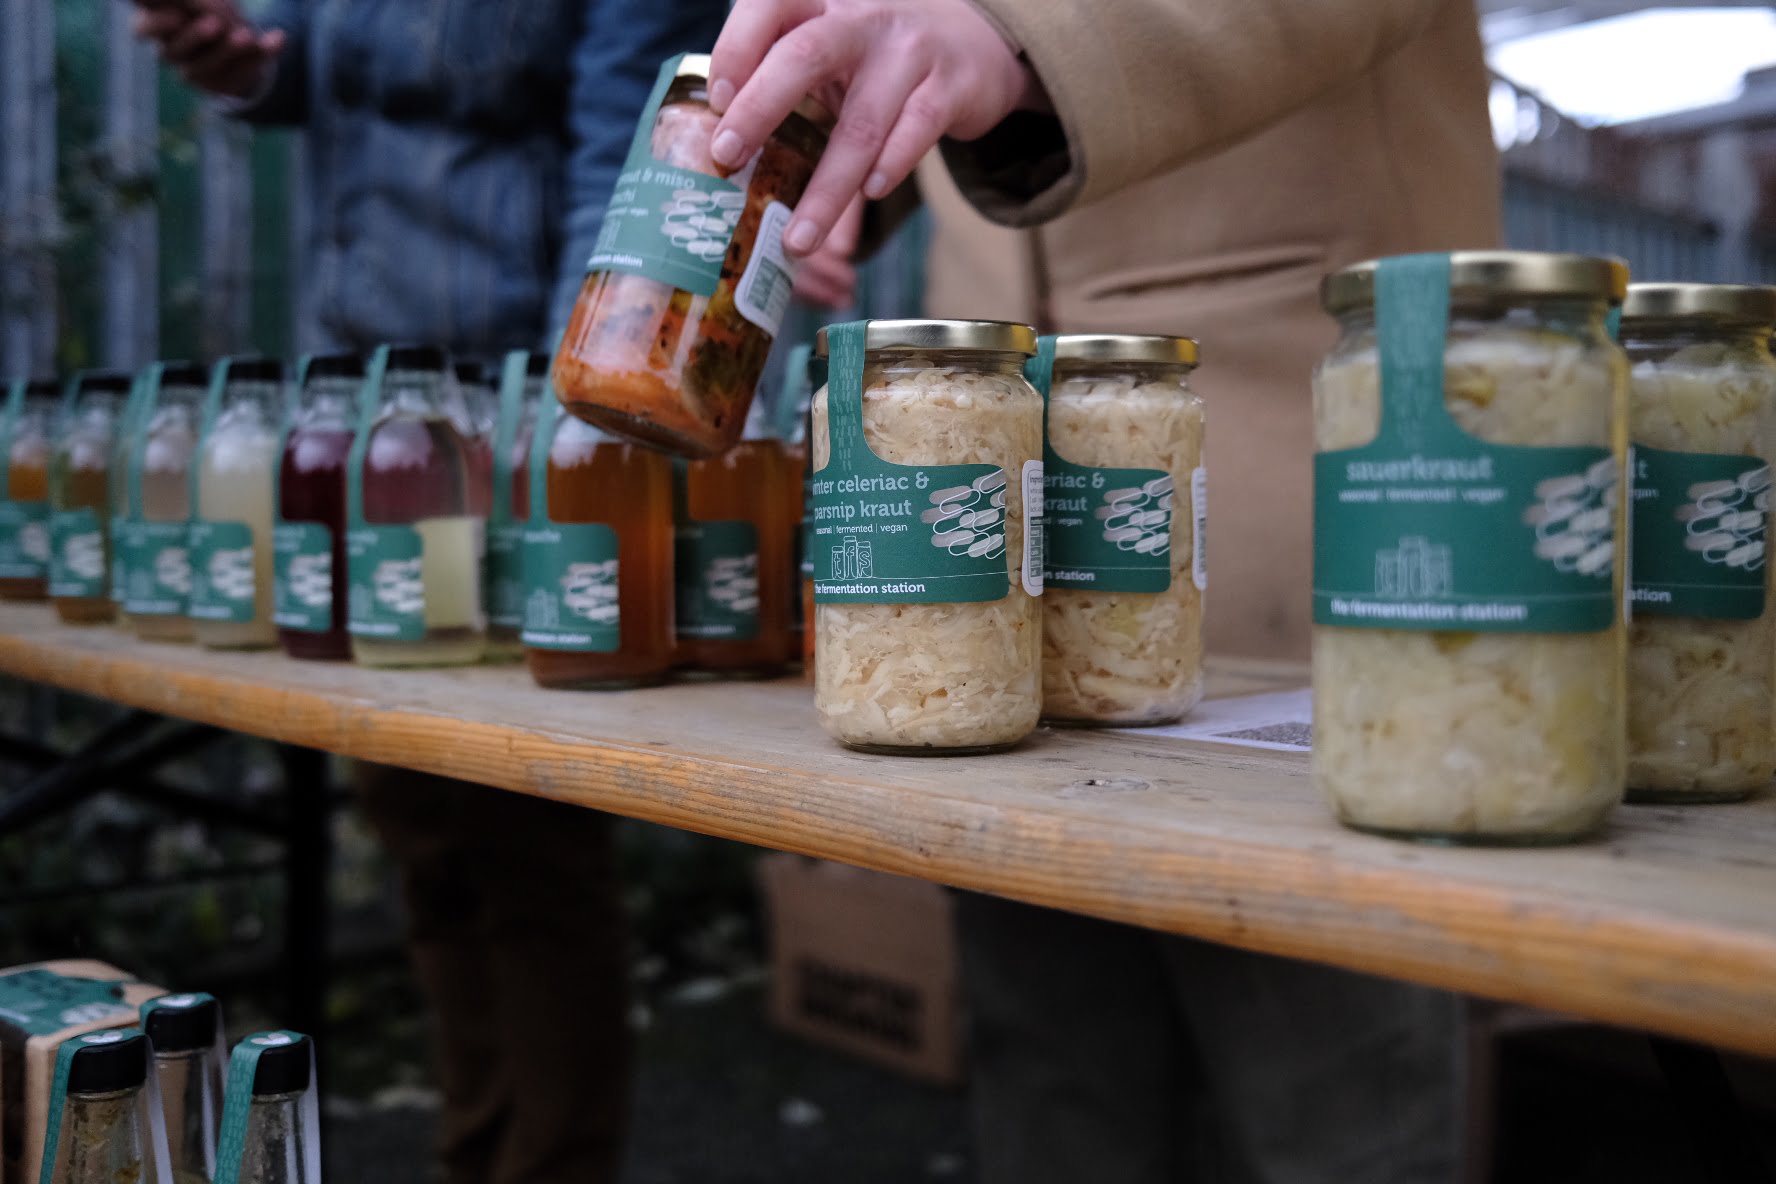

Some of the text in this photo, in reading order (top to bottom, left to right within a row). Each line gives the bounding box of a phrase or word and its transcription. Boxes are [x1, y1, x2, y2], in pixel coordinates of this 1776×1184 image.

[1346, 454, 1492, 481] sauerkraut
[813, 471, 930, 495] inter celeriac &
[1091, 472, 1104, 489] &
[814, 500, 912, 522] parsnip kraut
[835, 523, 873, 533] fermented
[880, 524, 908, 533] vegan
[1055, 569, 1095, 580] station
[821, 583, 878, 594] fermentation
[881, 582, 926, 594] station
[1351, 600, 1457, 620] fermentation
[1460, 604, 1527, 621] station
